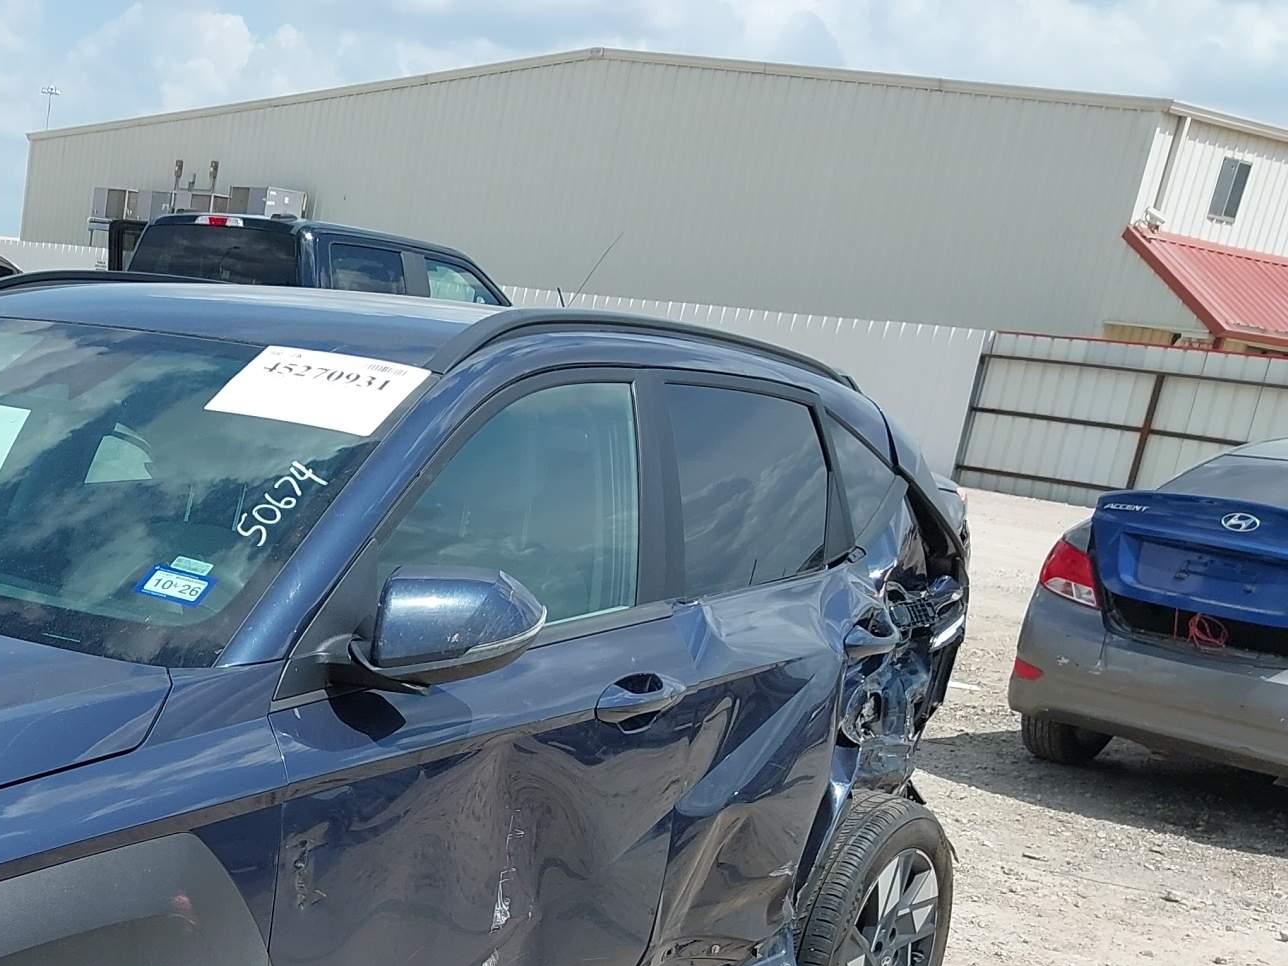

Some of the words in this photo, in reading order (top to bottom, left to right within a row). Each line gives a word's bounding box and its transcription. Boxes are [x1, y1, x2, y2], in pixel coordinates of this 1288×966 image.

[263, 362, 391, 391] 45270931
[237, 460, 328, 547] 50674
[1103, 503, 1150, 512] ACCENT
[153, 578, 174, 590] 10
[178, 584, 201, 597] 26
